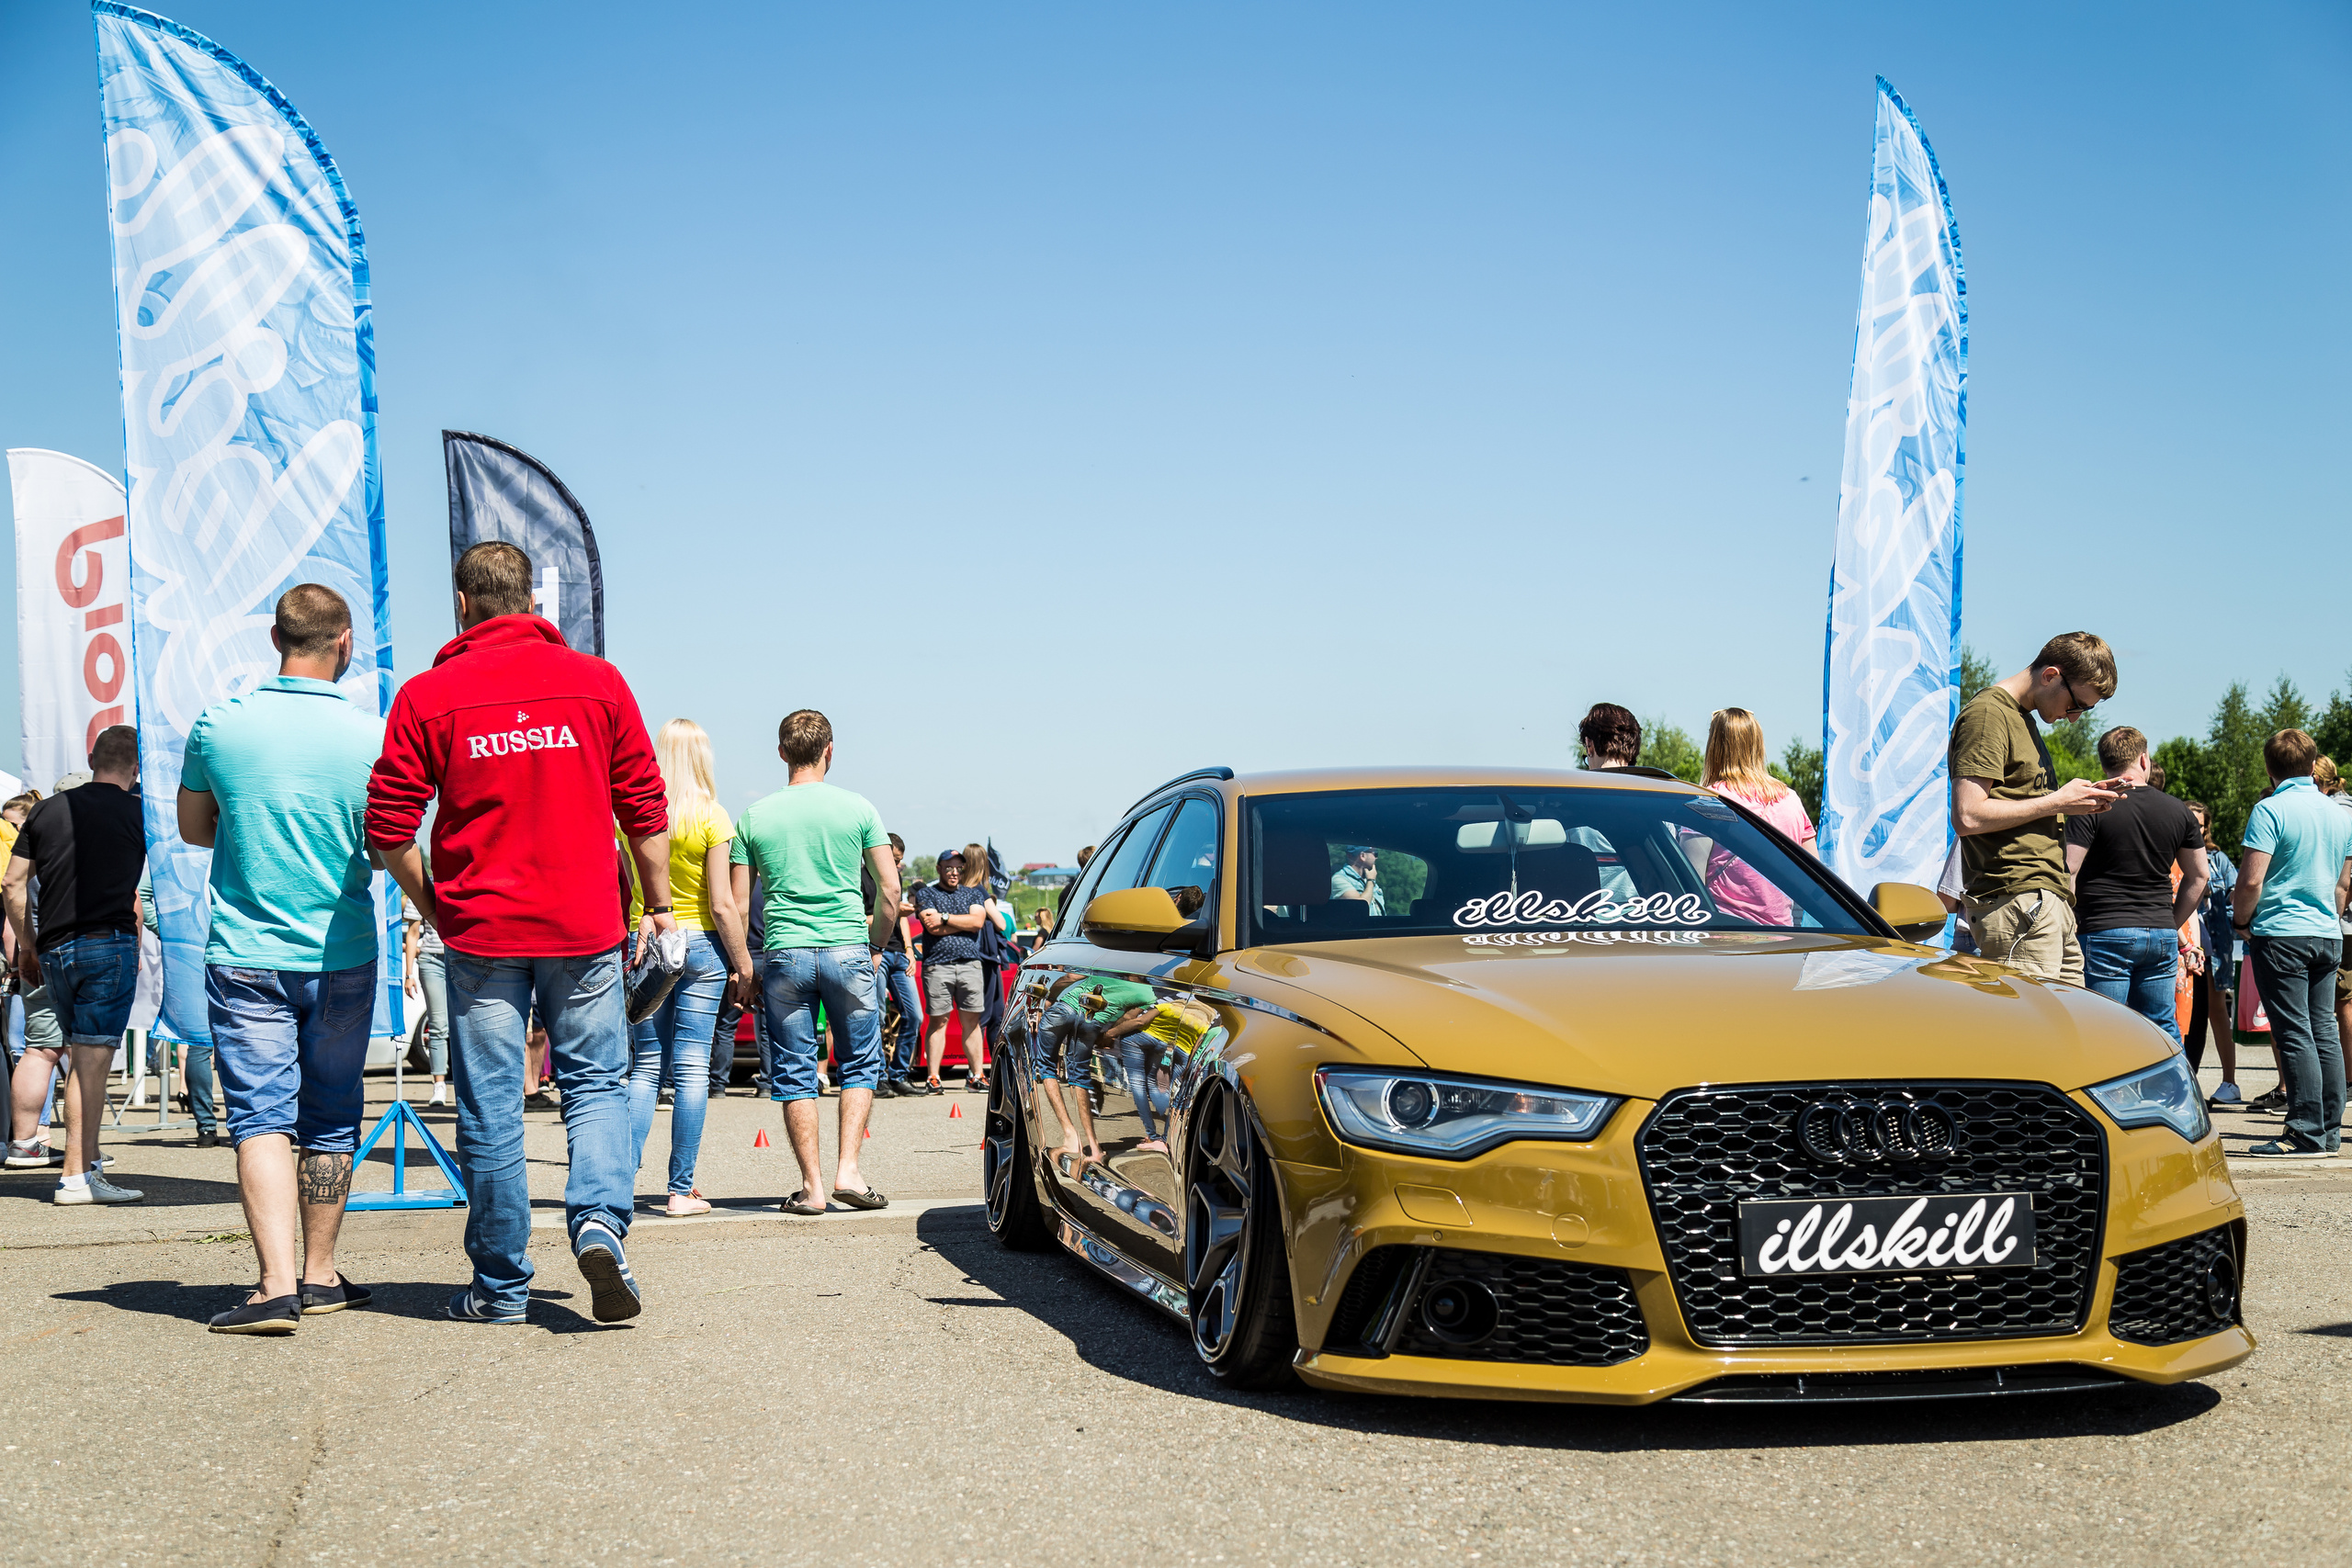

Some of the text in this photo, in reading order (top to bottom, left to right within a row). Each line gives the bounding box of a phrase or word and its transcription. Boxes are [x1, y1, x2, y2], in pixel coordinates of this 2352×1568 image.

[467, 725, 579, 759] RUSSIA
[1453, 888, 1713, 928] illskill
[1758, 1197, 2018, 1274] illskill
